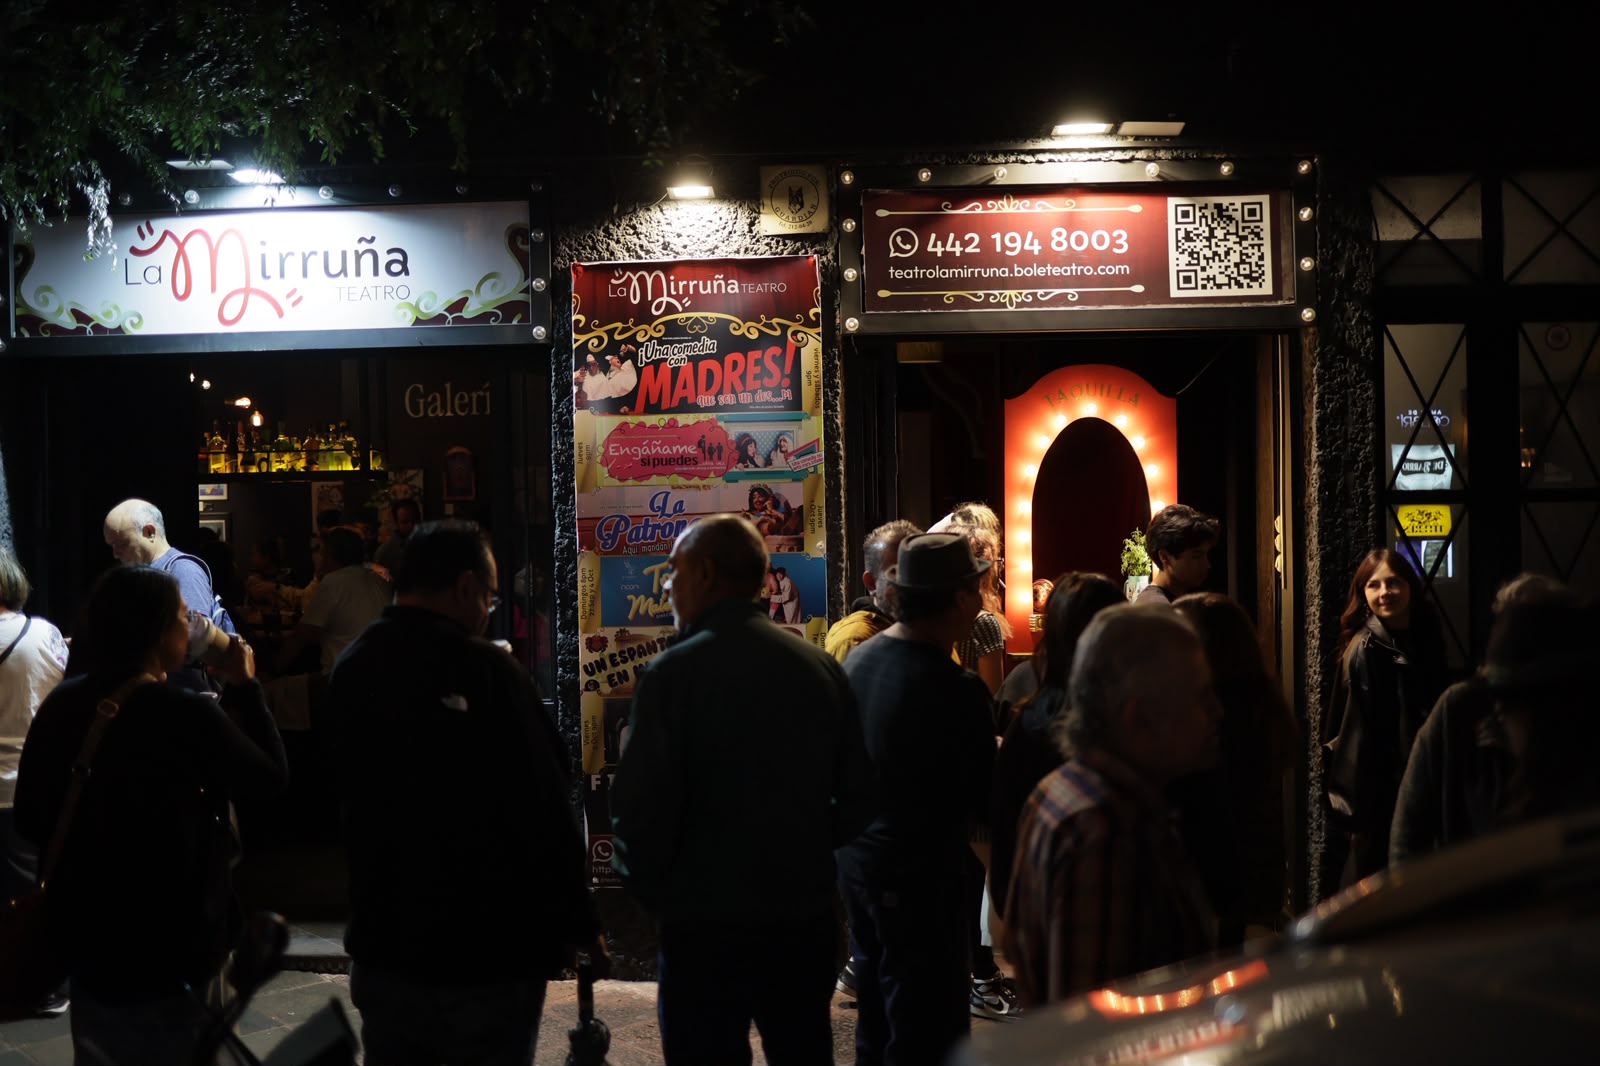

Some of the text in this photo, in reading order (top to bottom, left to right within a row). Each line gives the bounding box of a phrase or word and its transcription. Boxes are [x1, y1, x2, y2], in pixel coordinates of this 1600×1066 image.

[774, 203, 817, 222] GUARDIAN
[926, 227, 1129, 257] 442 194 8003
[125, 226, 410, 326] La Mirruña
[889, 261, 1130, 280] teatrolamirruna.boleteatro.com
[337, 285, 411, 302] TEATRO
[609, 270, 787, 315] La Mirruña TEATRO
[670, 337, 718, 360] comedia
[666, 356, 689, 368] con
[634, 338, 800, 413] MADRES!
[696, 394, 717, 409] que
[718, 393, 738, 406] son
[738, 391, 754, 405] un
[1043, 383, 1141, 408] TAQUILLA
[608, 440, 698, 461] Engáñame
[652, 455, 699, 469] puedes
[649, 490, 686, 520] La
[642, 543, 668, 553] mandan
[582, 657, 608, 677] UN
[606, 669, 630, 688] EN
